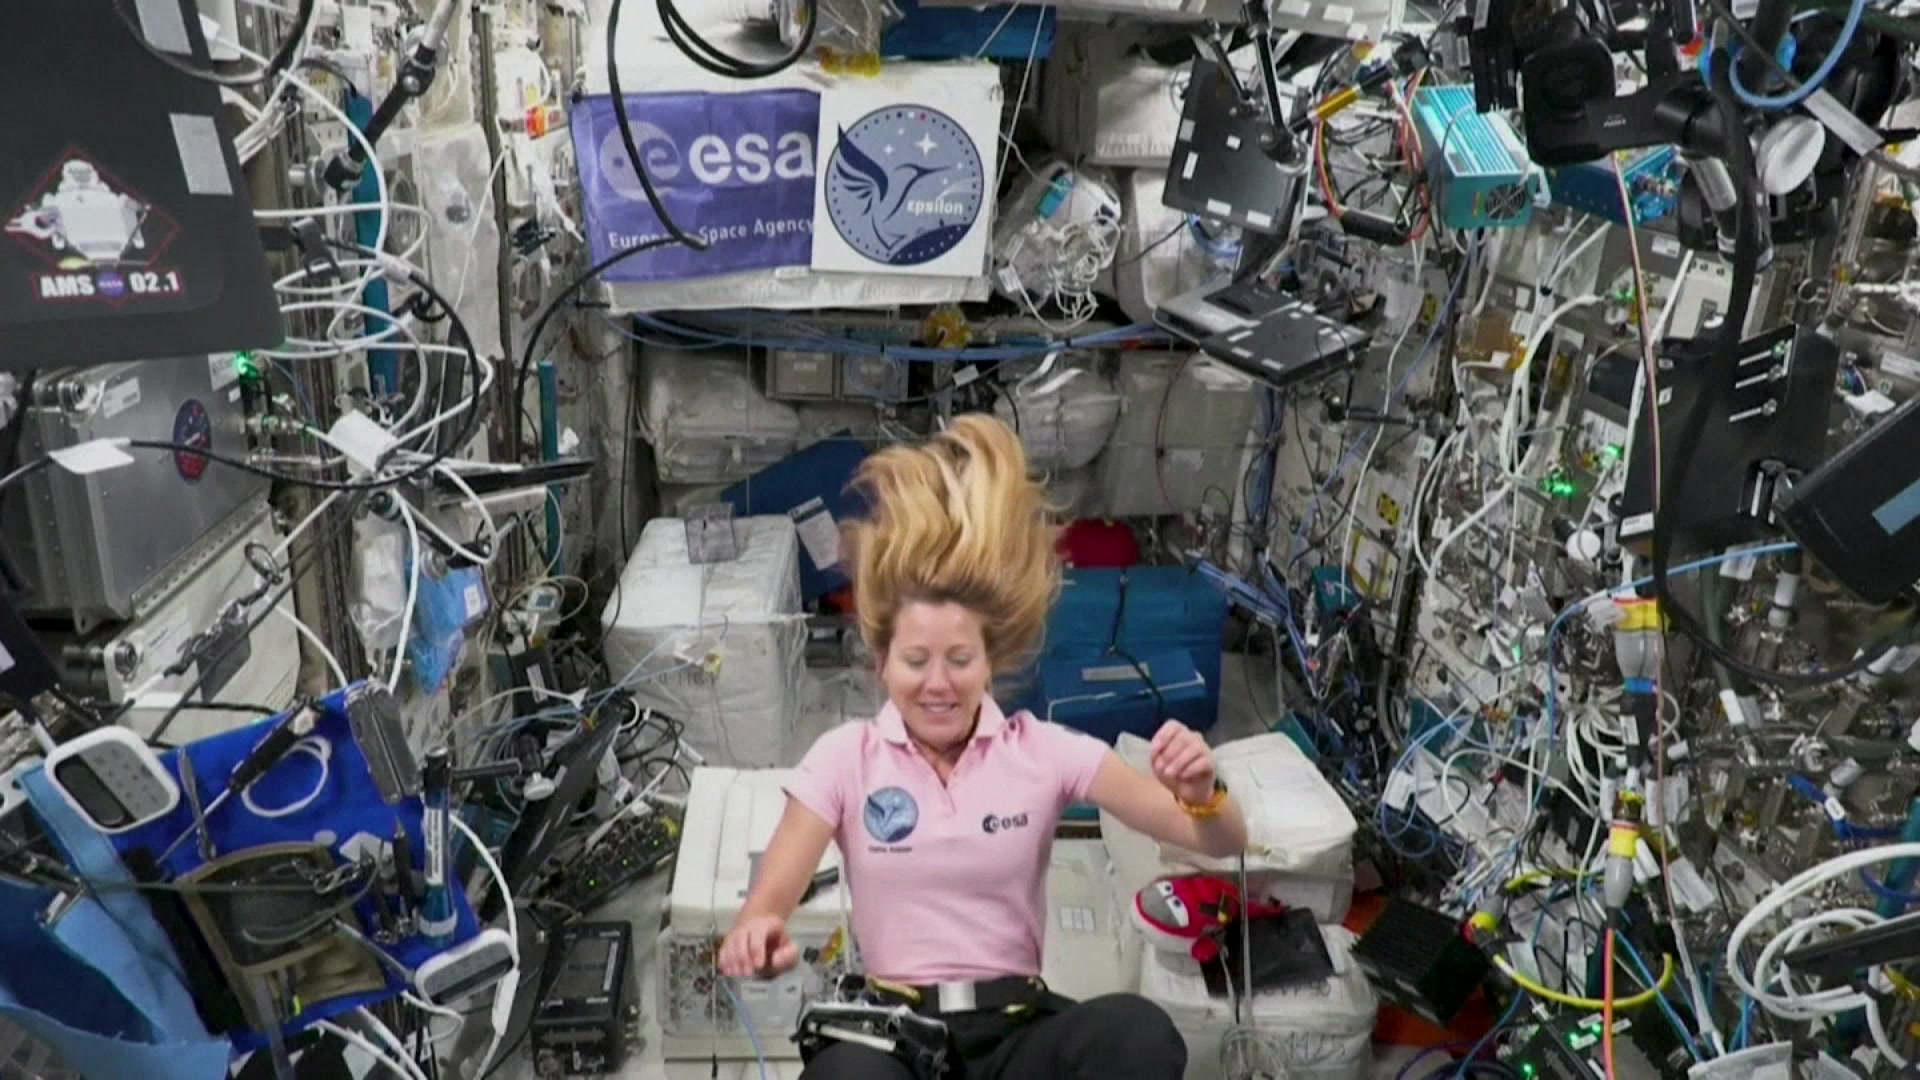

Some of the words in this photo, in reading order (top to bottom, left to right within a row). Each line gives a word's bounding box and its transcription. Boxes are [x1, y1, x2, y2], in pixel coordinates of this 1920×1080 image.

[688, 131, 815, 184] esa
[698, 224, 747, 244] Space
[753, 218, 813, 239] Agency
[40, 274, 95, 297] AMS
[129, 271, 179, 293] 02.1
